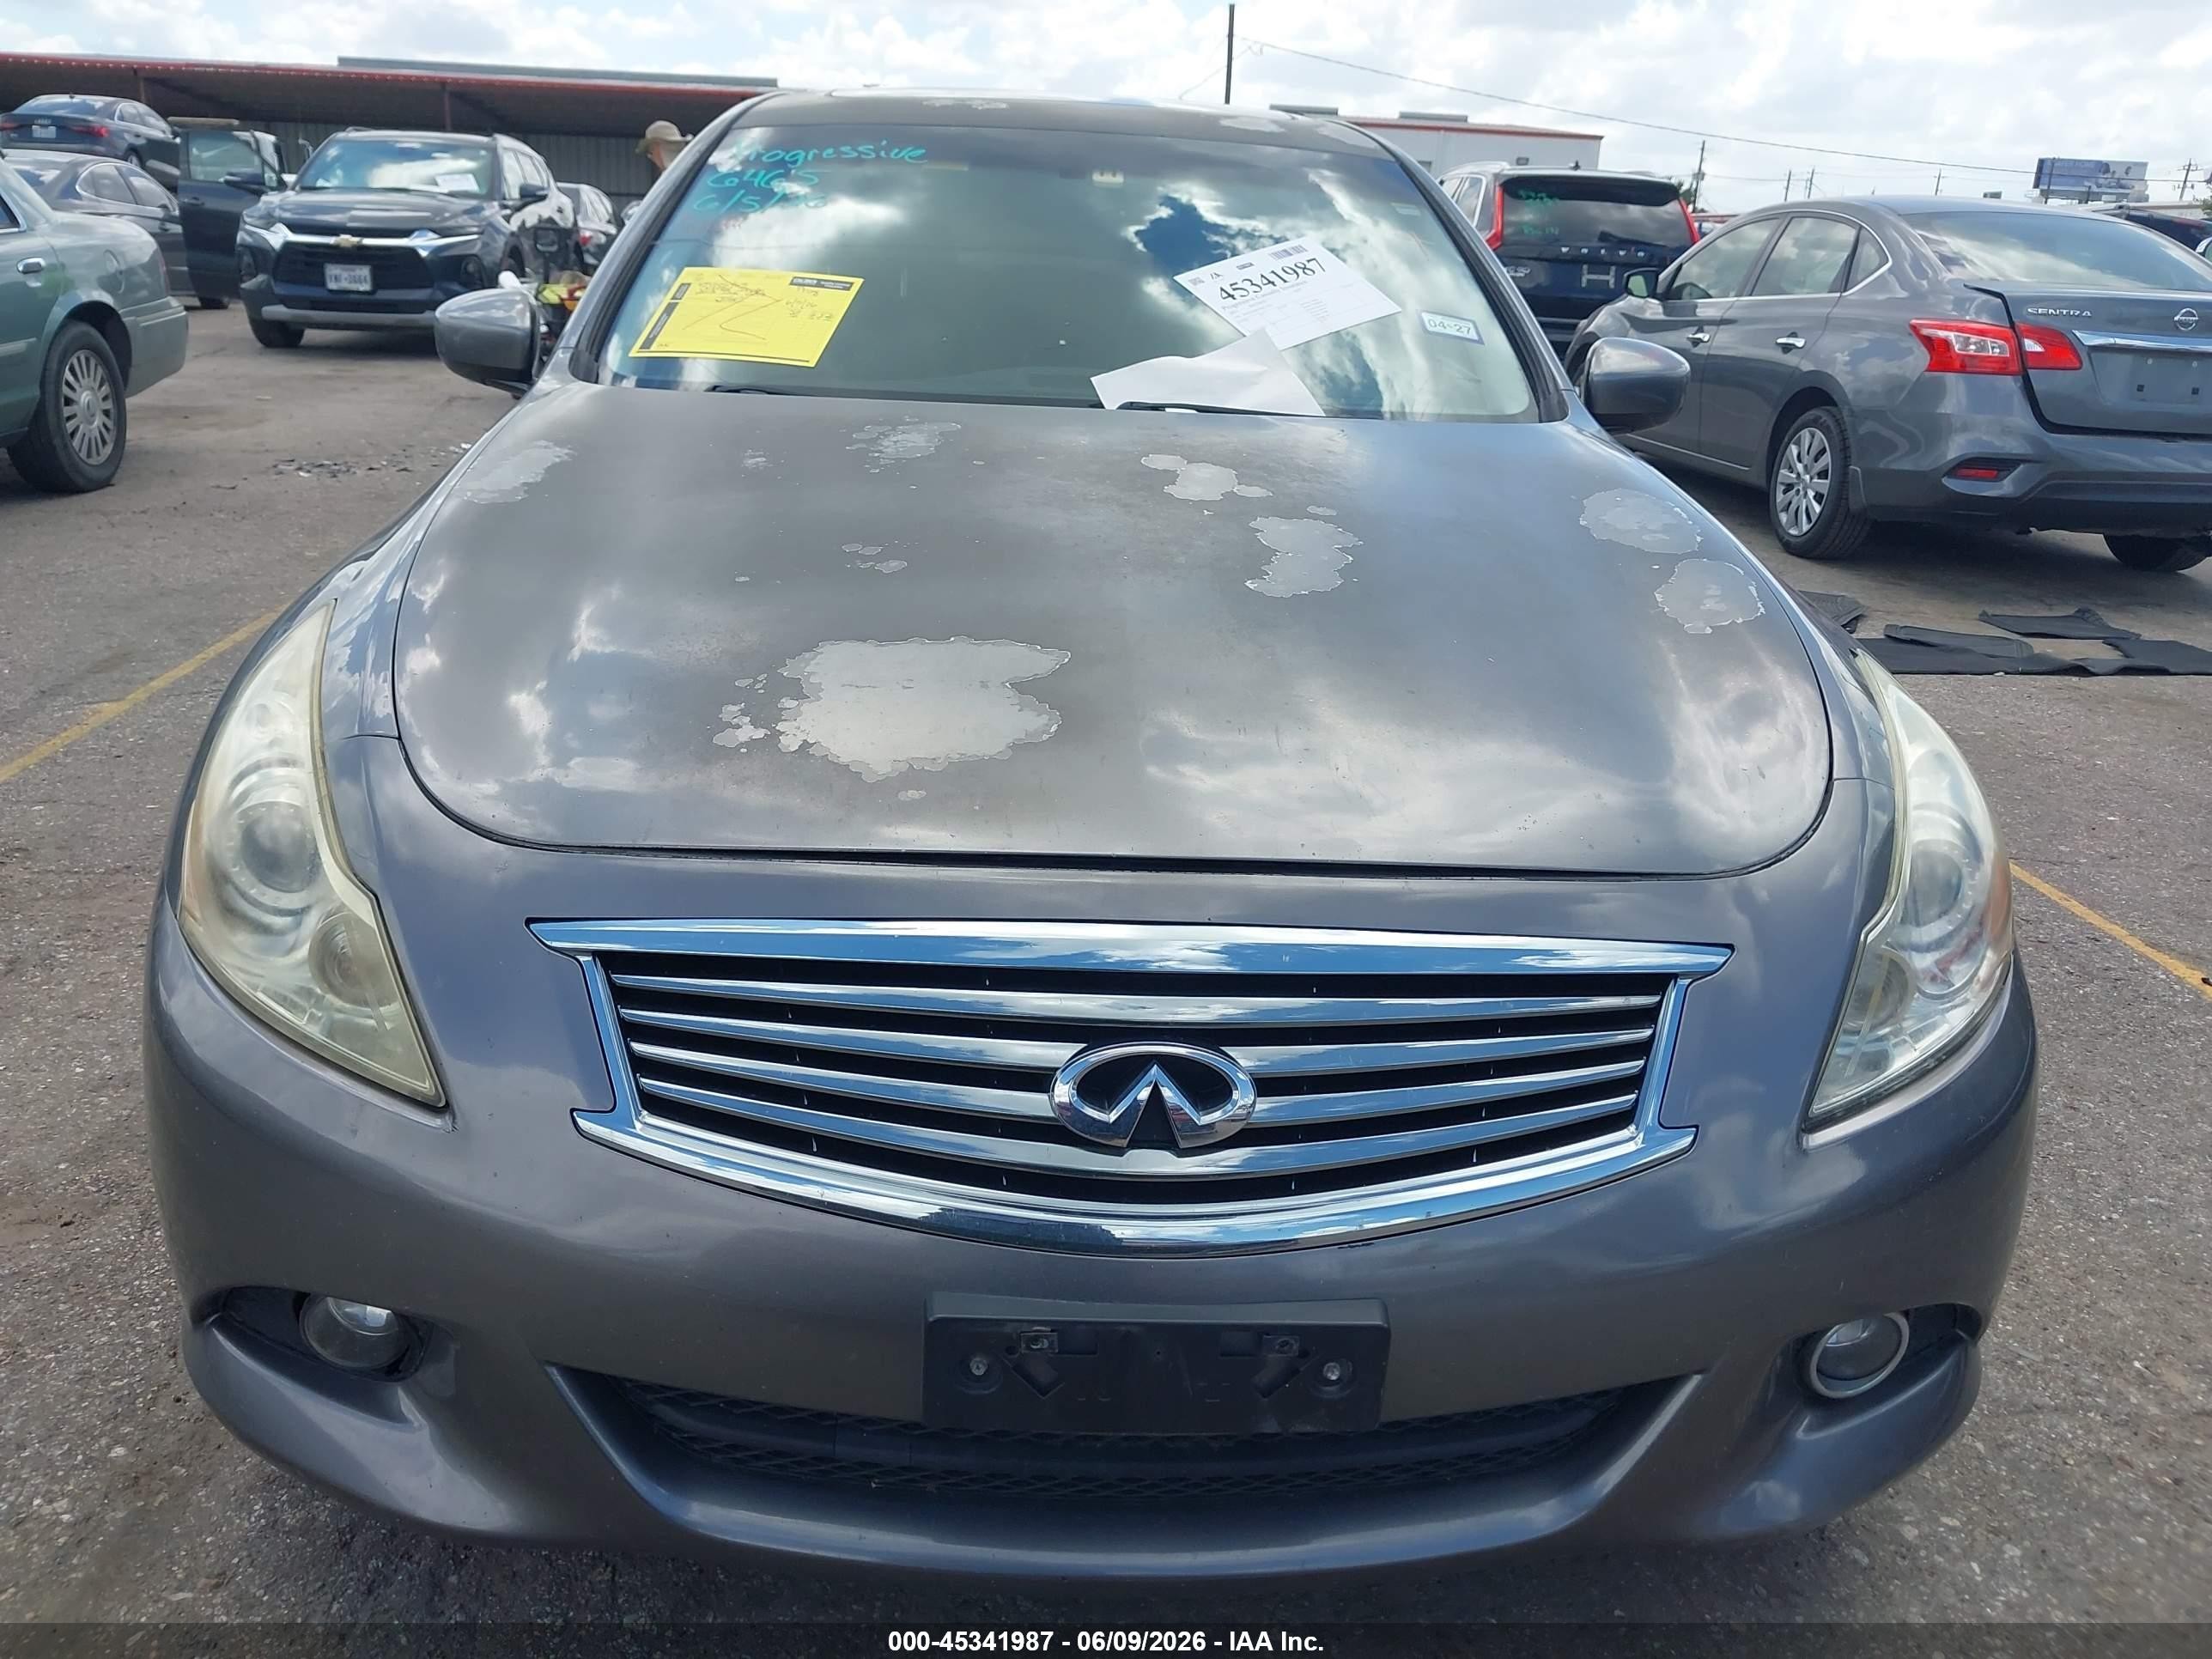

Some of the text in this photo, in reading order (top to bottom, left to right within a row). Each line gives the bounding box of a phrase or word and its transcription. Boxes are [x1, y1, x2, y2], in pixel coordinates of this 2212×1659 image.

[732, 140, 928, 167] rogressive
[1561, 246, 1644, 258] VOLVO
[1218, 258, 1326, 301] 45341987
[2027, 307, 2093, 318] SENTRA
